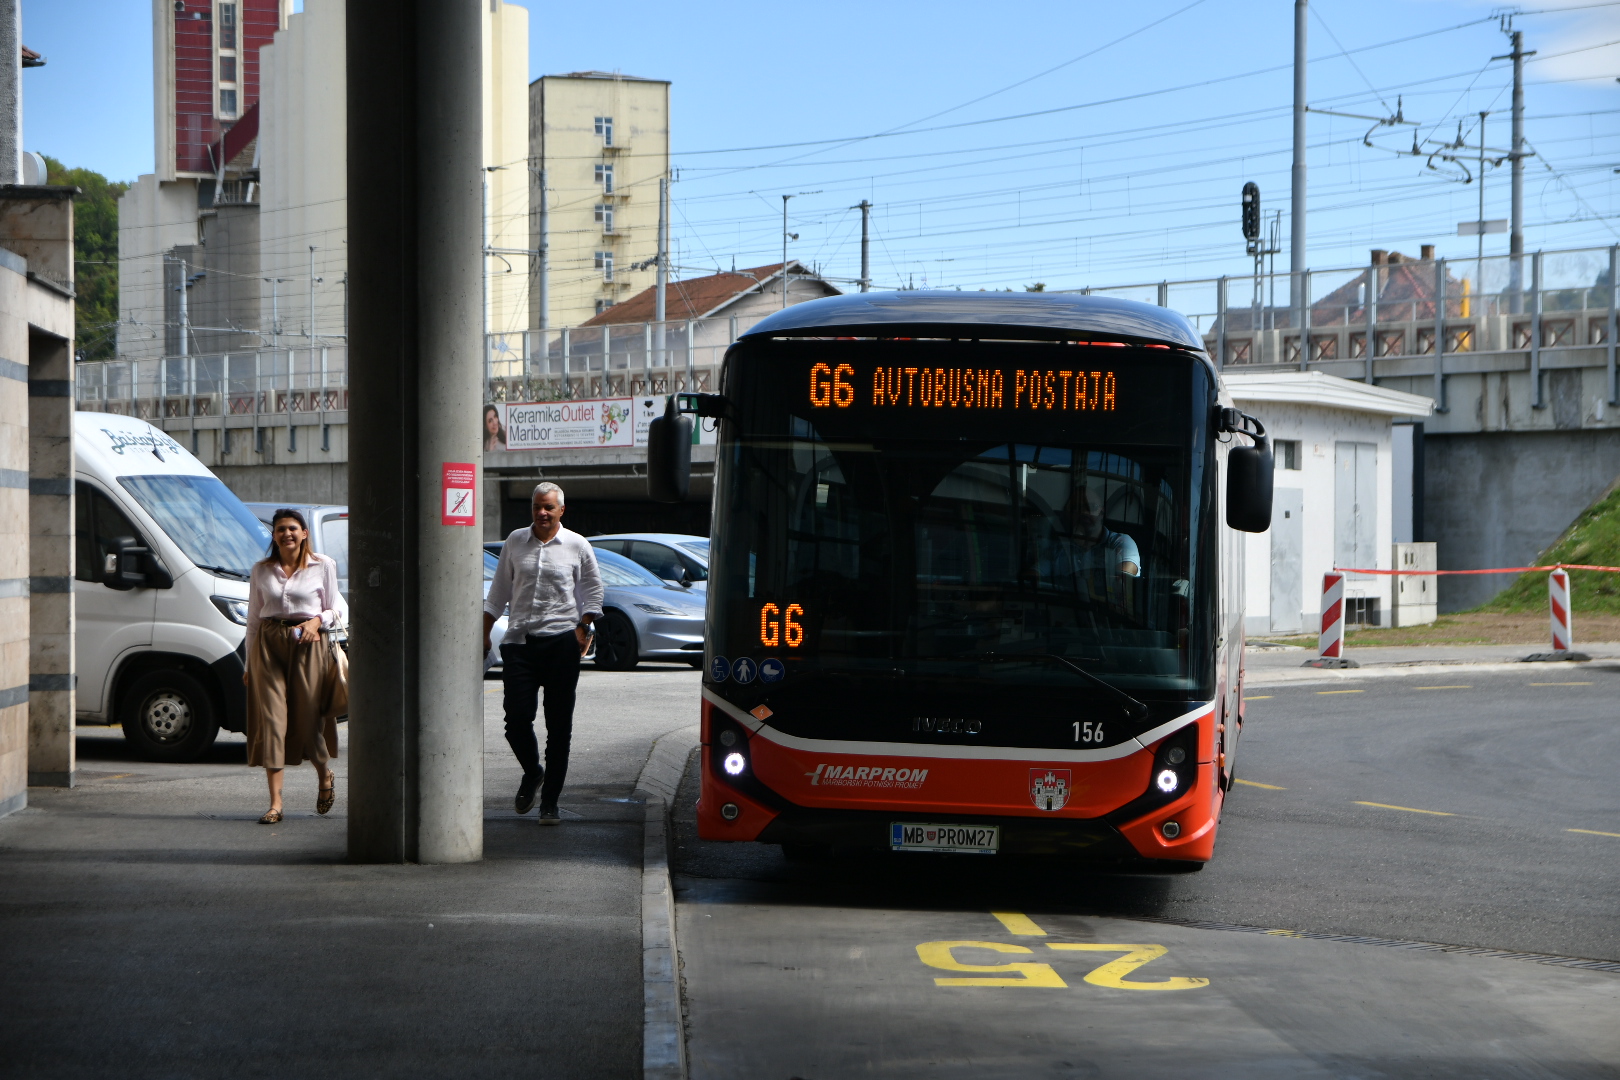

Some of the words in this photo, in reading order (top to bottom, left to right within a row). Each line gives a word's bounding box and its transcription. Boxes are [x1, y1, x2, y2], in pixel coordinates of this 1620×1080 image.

[809, 362, 855, 408] G6
[873, 366, 1003, 408] AVTOBUSNA
[1015, 369, 1116, 411] POSTAJA
[509, 404, 595, 424] KeramikaOutlet
[509, 425, 552, 441] Maribor
[760, 602, 804, 648] G6
[912, 716, 982, 734] IVECO
[1072, 721, 1104, 743] 156
[821, 778, 862, 787] MARIBORSKI
[863, 779, 894, 788] POTNIŠKI
[894, 781, 923, 789] PROMET
[824, 765, 929, 782] MARPROM
[904, 827, 924, 844] MB
[938, 828, 995, 847] PROM27
[916, 940, 1210, 991] 25
